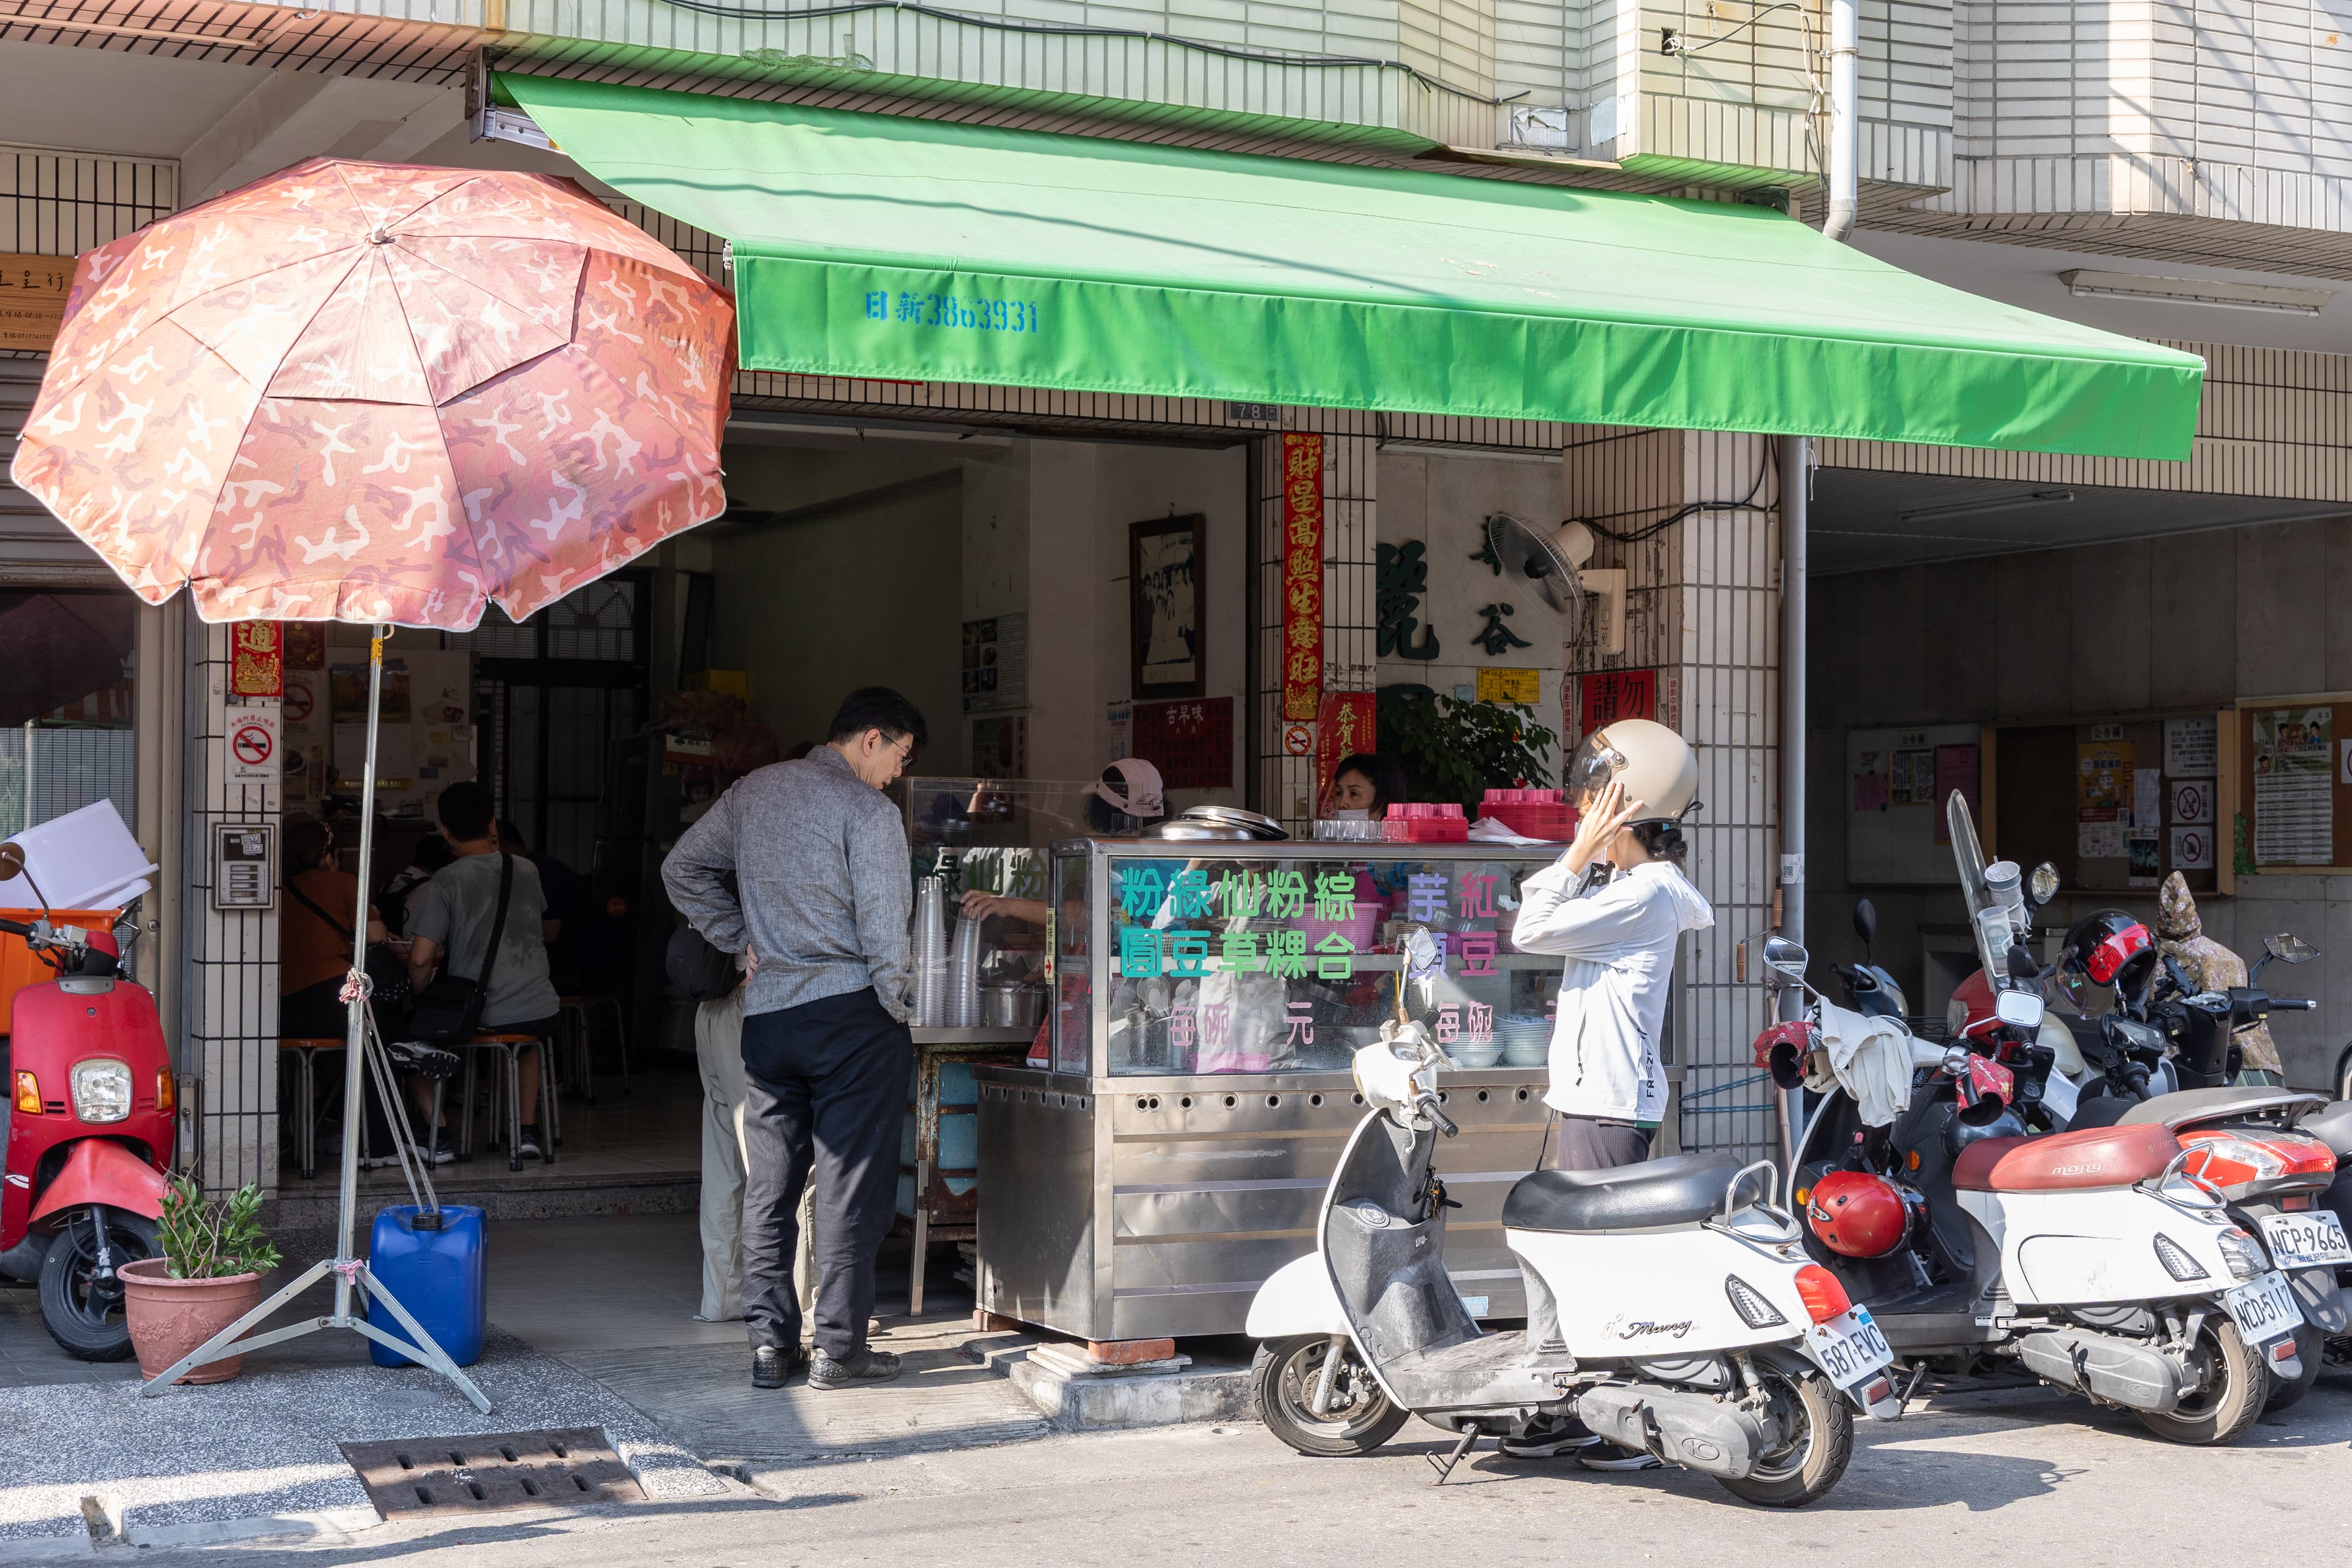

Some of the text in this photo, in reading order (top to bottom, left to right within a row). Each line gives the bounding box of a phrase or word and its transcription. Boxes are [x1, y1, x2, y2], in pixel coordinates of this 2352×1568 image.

[1238, 404, 1261, 419] 78
[1287, 448, 1319, 683] 財星高照生意旺
[1166, 704, 1204, 726] 古早味
[1170, 1001, 1314, 1047] 每碗 元
[1435, 1000, 1494, 1044] 每碗
[2052, 1163, 2103, 1176] many
[2268, 1224, 2347, 1257] NCP-9665
[2234, 1284, 2293, 1332] NCD-5117
[1822, 1324, 1887, 1379] 587-EVC
